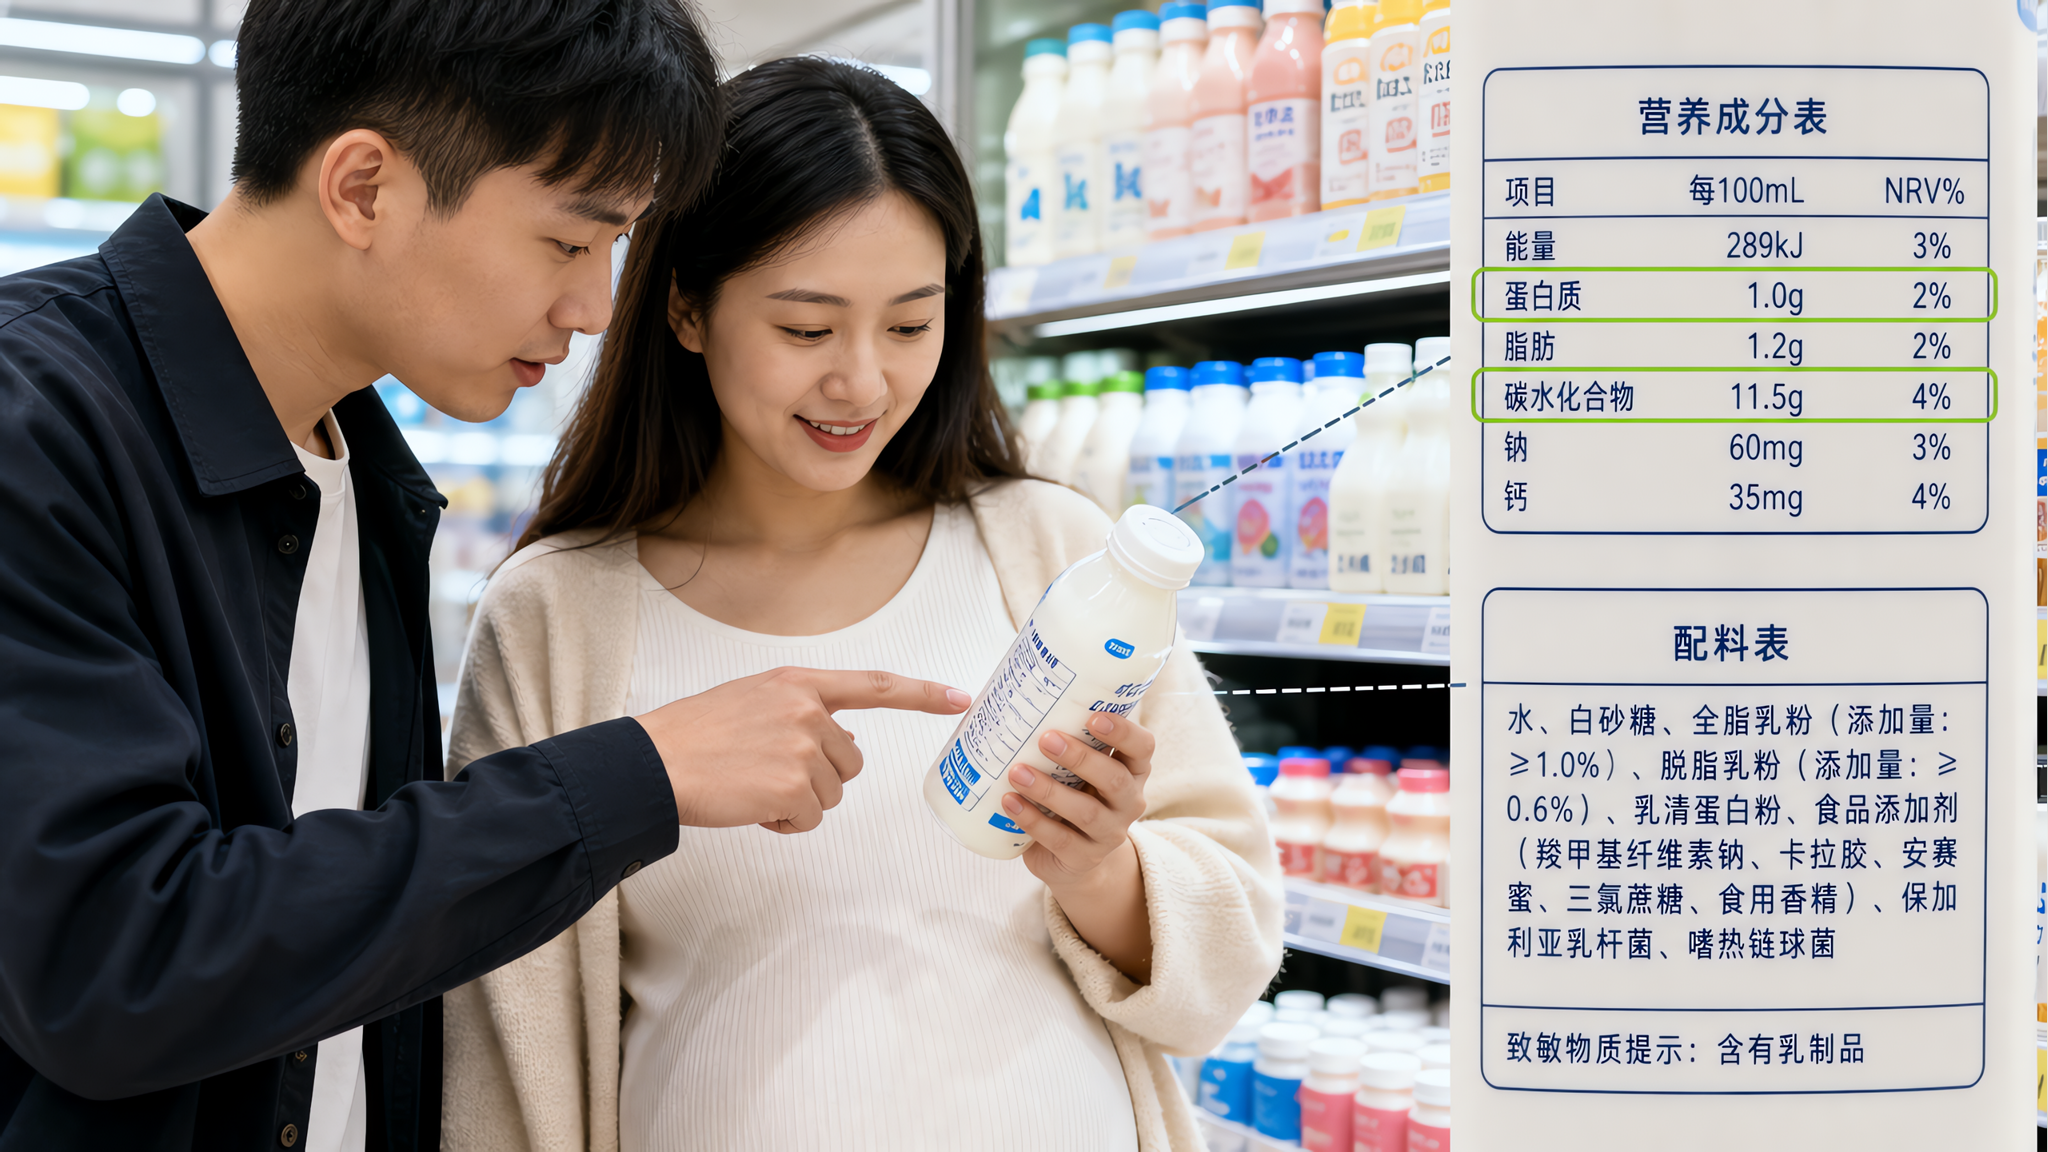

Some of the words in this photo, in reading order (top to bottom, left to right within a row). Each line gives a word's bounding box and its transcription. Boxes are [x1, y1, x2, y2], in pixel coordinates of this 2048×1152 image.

[1638, 96, 1827, 136] 营养成分表
[1505, 176, 1554, 208] 项目
[1688, 173, 1805, 206] 每100mL
[1885, 176, 1965, 205] NRV%
[1505, 230, 1556, 262] 能量
[1726, 230, 1803, 259] 289kJ
[1913, 231, 1952, 260] 3%
[1505, 279, 1582, 312] 蛋白质
[1748, 281, 1803, 317] 1.0g
[1912, 281, 1952, 310] 2%
[1504, 329, 1556, 362] 脂肪
[1748, 331, 1803, 366] 1.2g
[1912, 331, 1952, 360] 2%
[1504, 380, 1634, 413] 碳水化合物
[1731, 382, 1803, 418] 11.5g
[1911, 382, 1951, 411] 4%
[1504, 430, 1528, 463] 钠
[1729, 433, 1803, 468] 60mg
[1912, 432, 1951, 461] 3%
[1504, 479, 1528, 512] 钙
[1729, 482, 1803, 518] 35mg
[1911, 482, 1951, 510] 4%
[1673, 623, 1789, 663] 配料表
